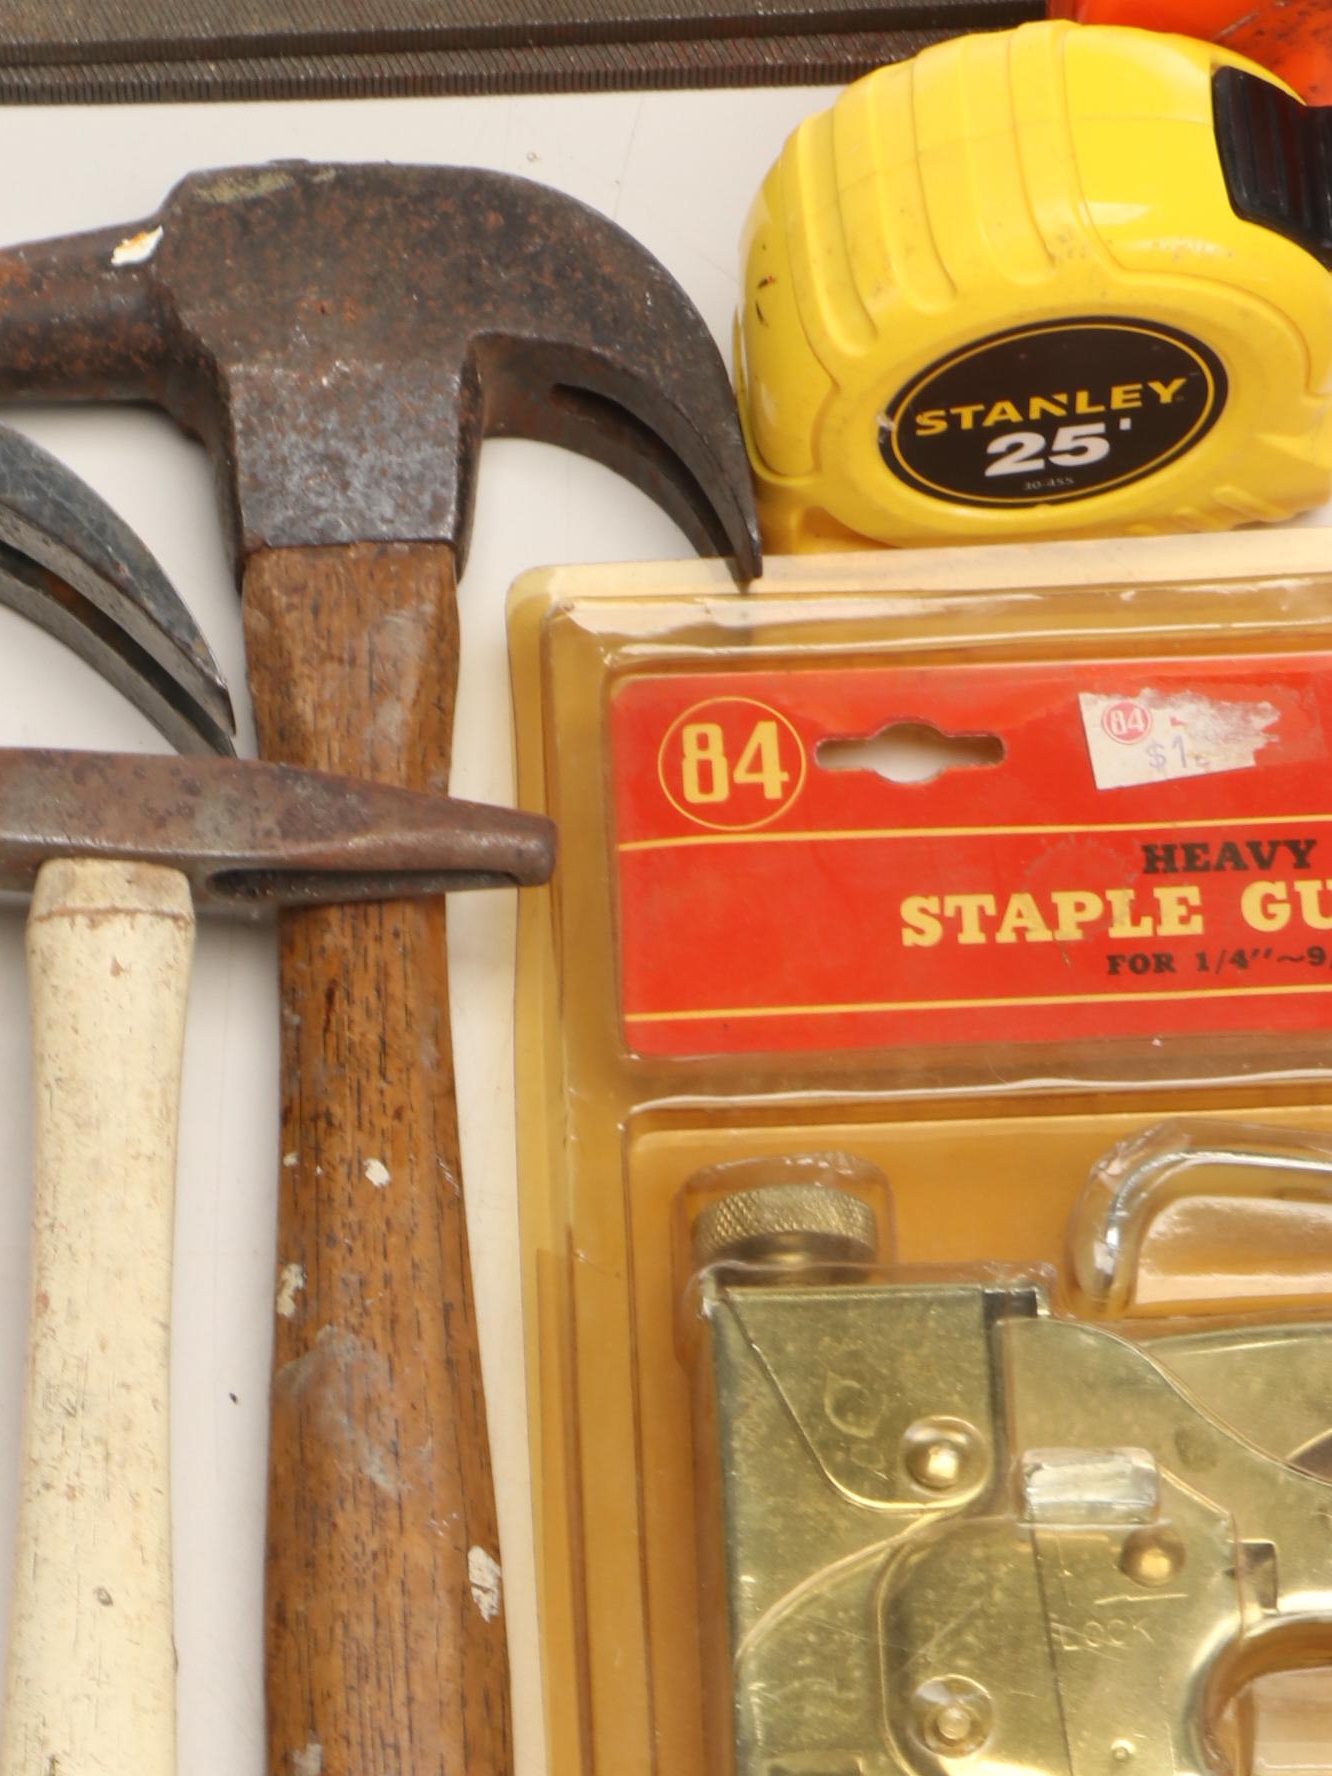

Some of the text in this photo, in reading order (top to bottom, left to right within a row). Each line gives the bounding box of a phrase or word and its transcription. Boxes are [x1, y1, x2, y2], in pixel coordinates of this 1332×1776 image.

[915, 377, 1188, 437] STANLEY
[984, 417, 1133, 478] 25'
[1109, 708, 1147, 736] 84
[681, 719, 790, 805] 84
[1141, 838, 1318, 875] HEAVY
[899, 884, 1206, 948] STAPLE
[1105, 951, 1178, 976] FOR
